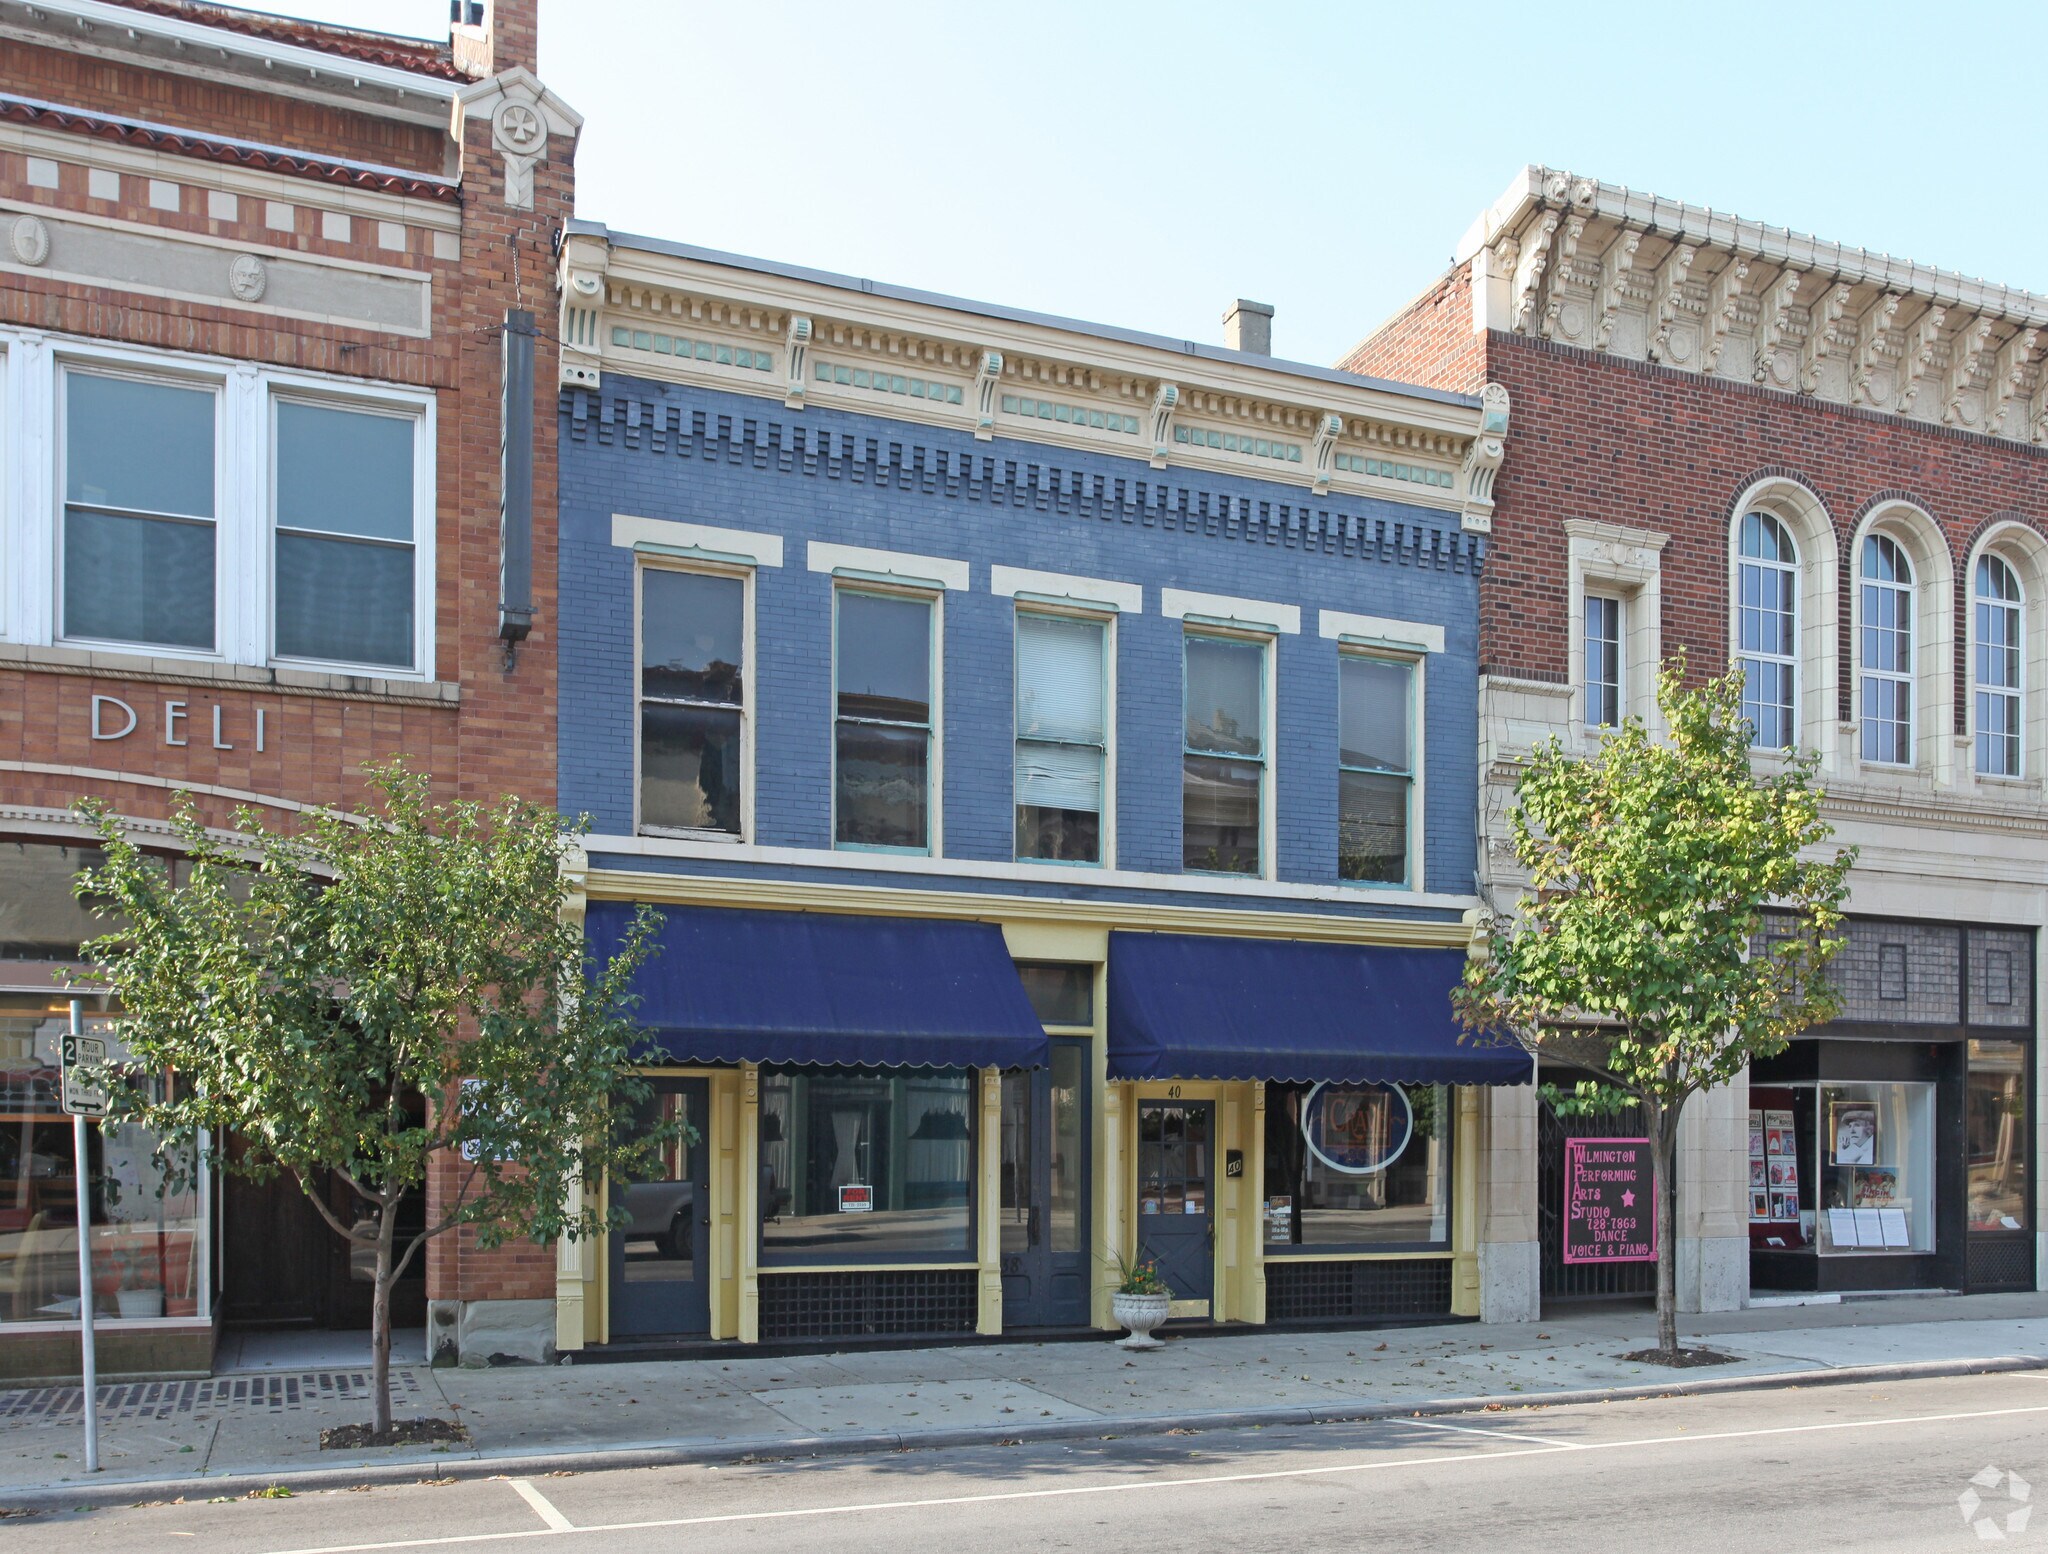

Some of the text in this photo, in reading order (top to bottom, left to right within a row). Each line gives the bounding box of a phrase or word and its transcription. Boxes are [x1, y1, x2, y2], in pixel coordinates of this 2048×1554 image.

[92, 694, 264, 752] DELI
[65, 1041, 99, 1060] 2 HOUR
[1168, 1085, 1181, 1098] 40
[1573, 1145, 1636, 1163] WILMINGTON
[1228, 1160, 1242, 1176] 40
[1573, 1164, 1637, 1182] PERFORMING
[1572, 1182, 1601, 1200] ARTS
[1571, 1200, 1610, 1219] STUDIO
[1587, 1218, 1637, 1230] 728-7863
[1594, 1230, 1628, 1242] DANCE
[1570, 1243, 1649, 1256] VOICE & PIANO
